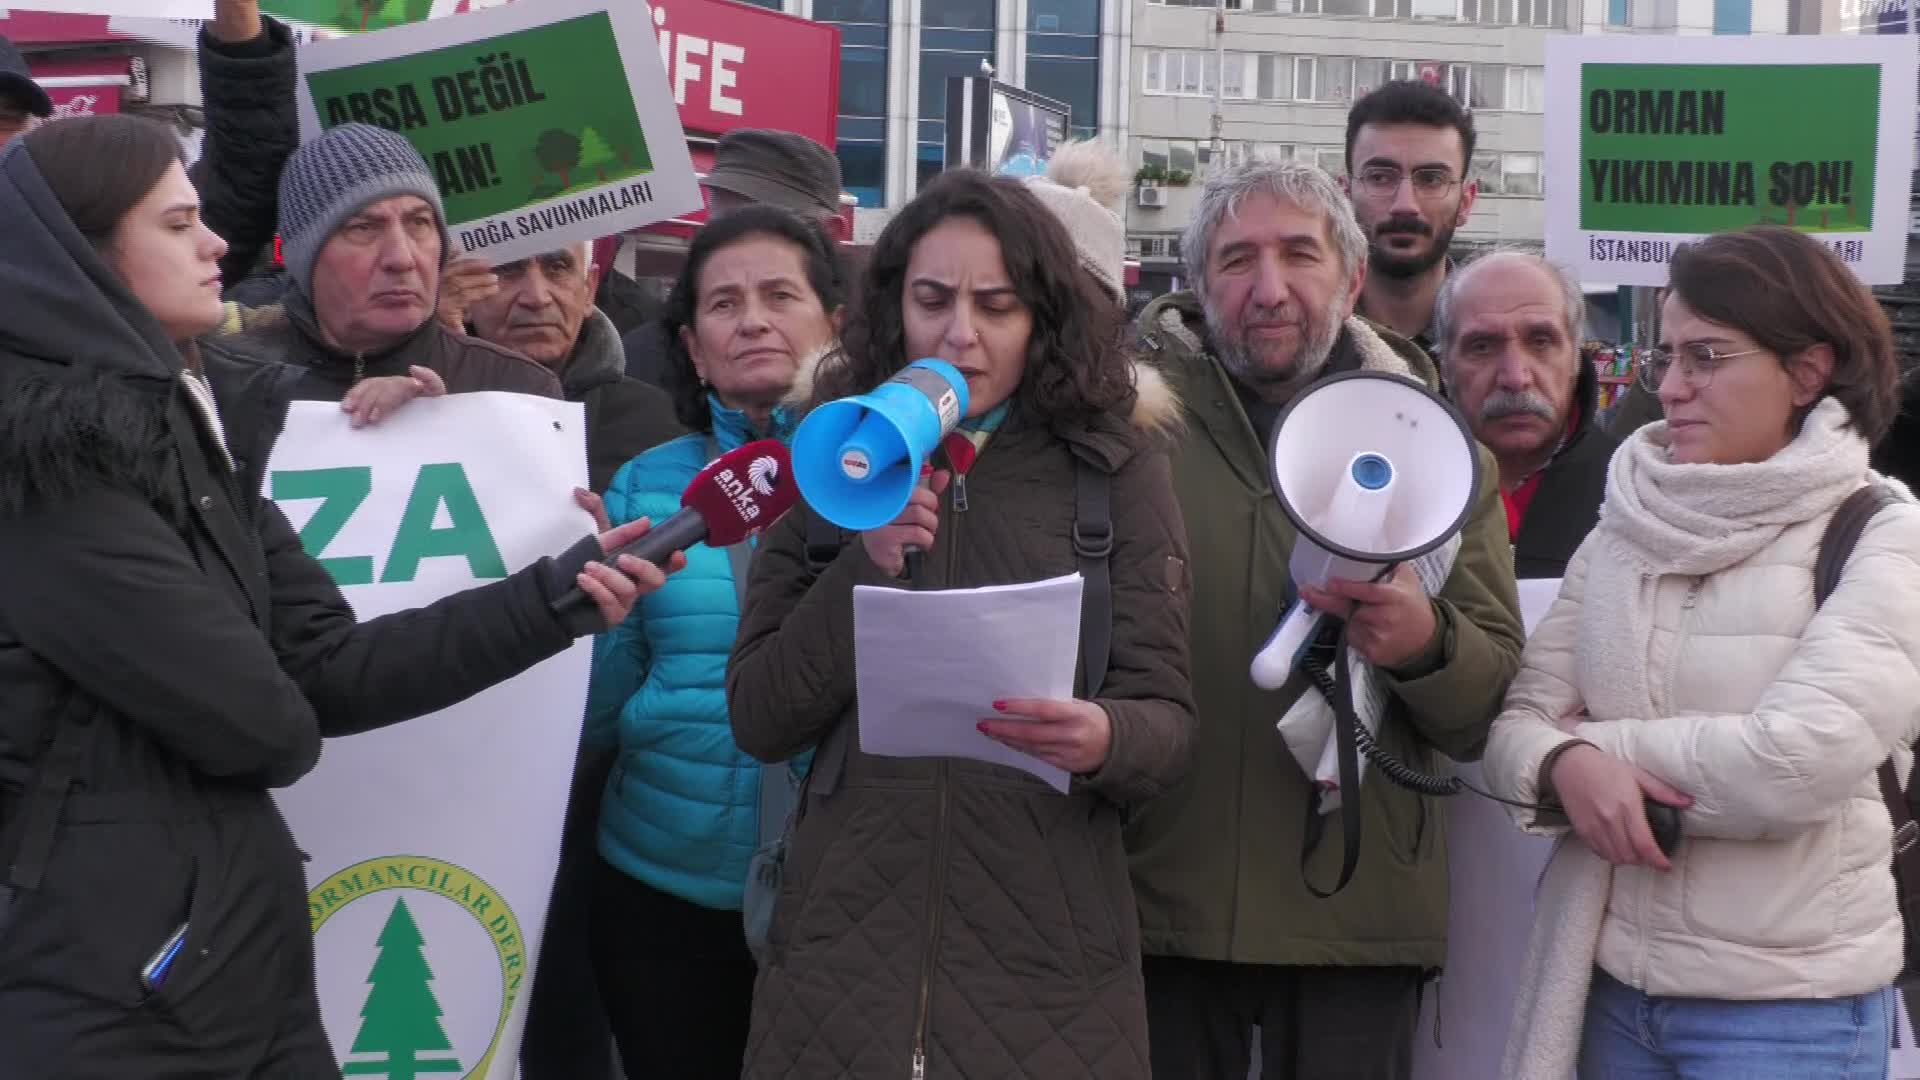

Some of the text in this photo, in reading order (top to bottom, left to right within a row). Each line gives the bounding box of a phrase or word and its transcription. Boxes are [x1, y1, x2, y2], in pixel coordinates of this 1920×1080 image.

[326, 51, 546, 131] ARSA DEĞİL
[650, 5, 745, 117] İFE
[1589, 89, 1725, 135] ORMAN
[436, 142, 503, 198] AN!
[1588, 159, 1854, 207] YIKIMINA SON!
[460, 181, 654, 252] DOĞA SAVUNMALARI
[718, 469, 761, 519] anka
[310, 863, 522, 1000] ORMANCILAR DERN
